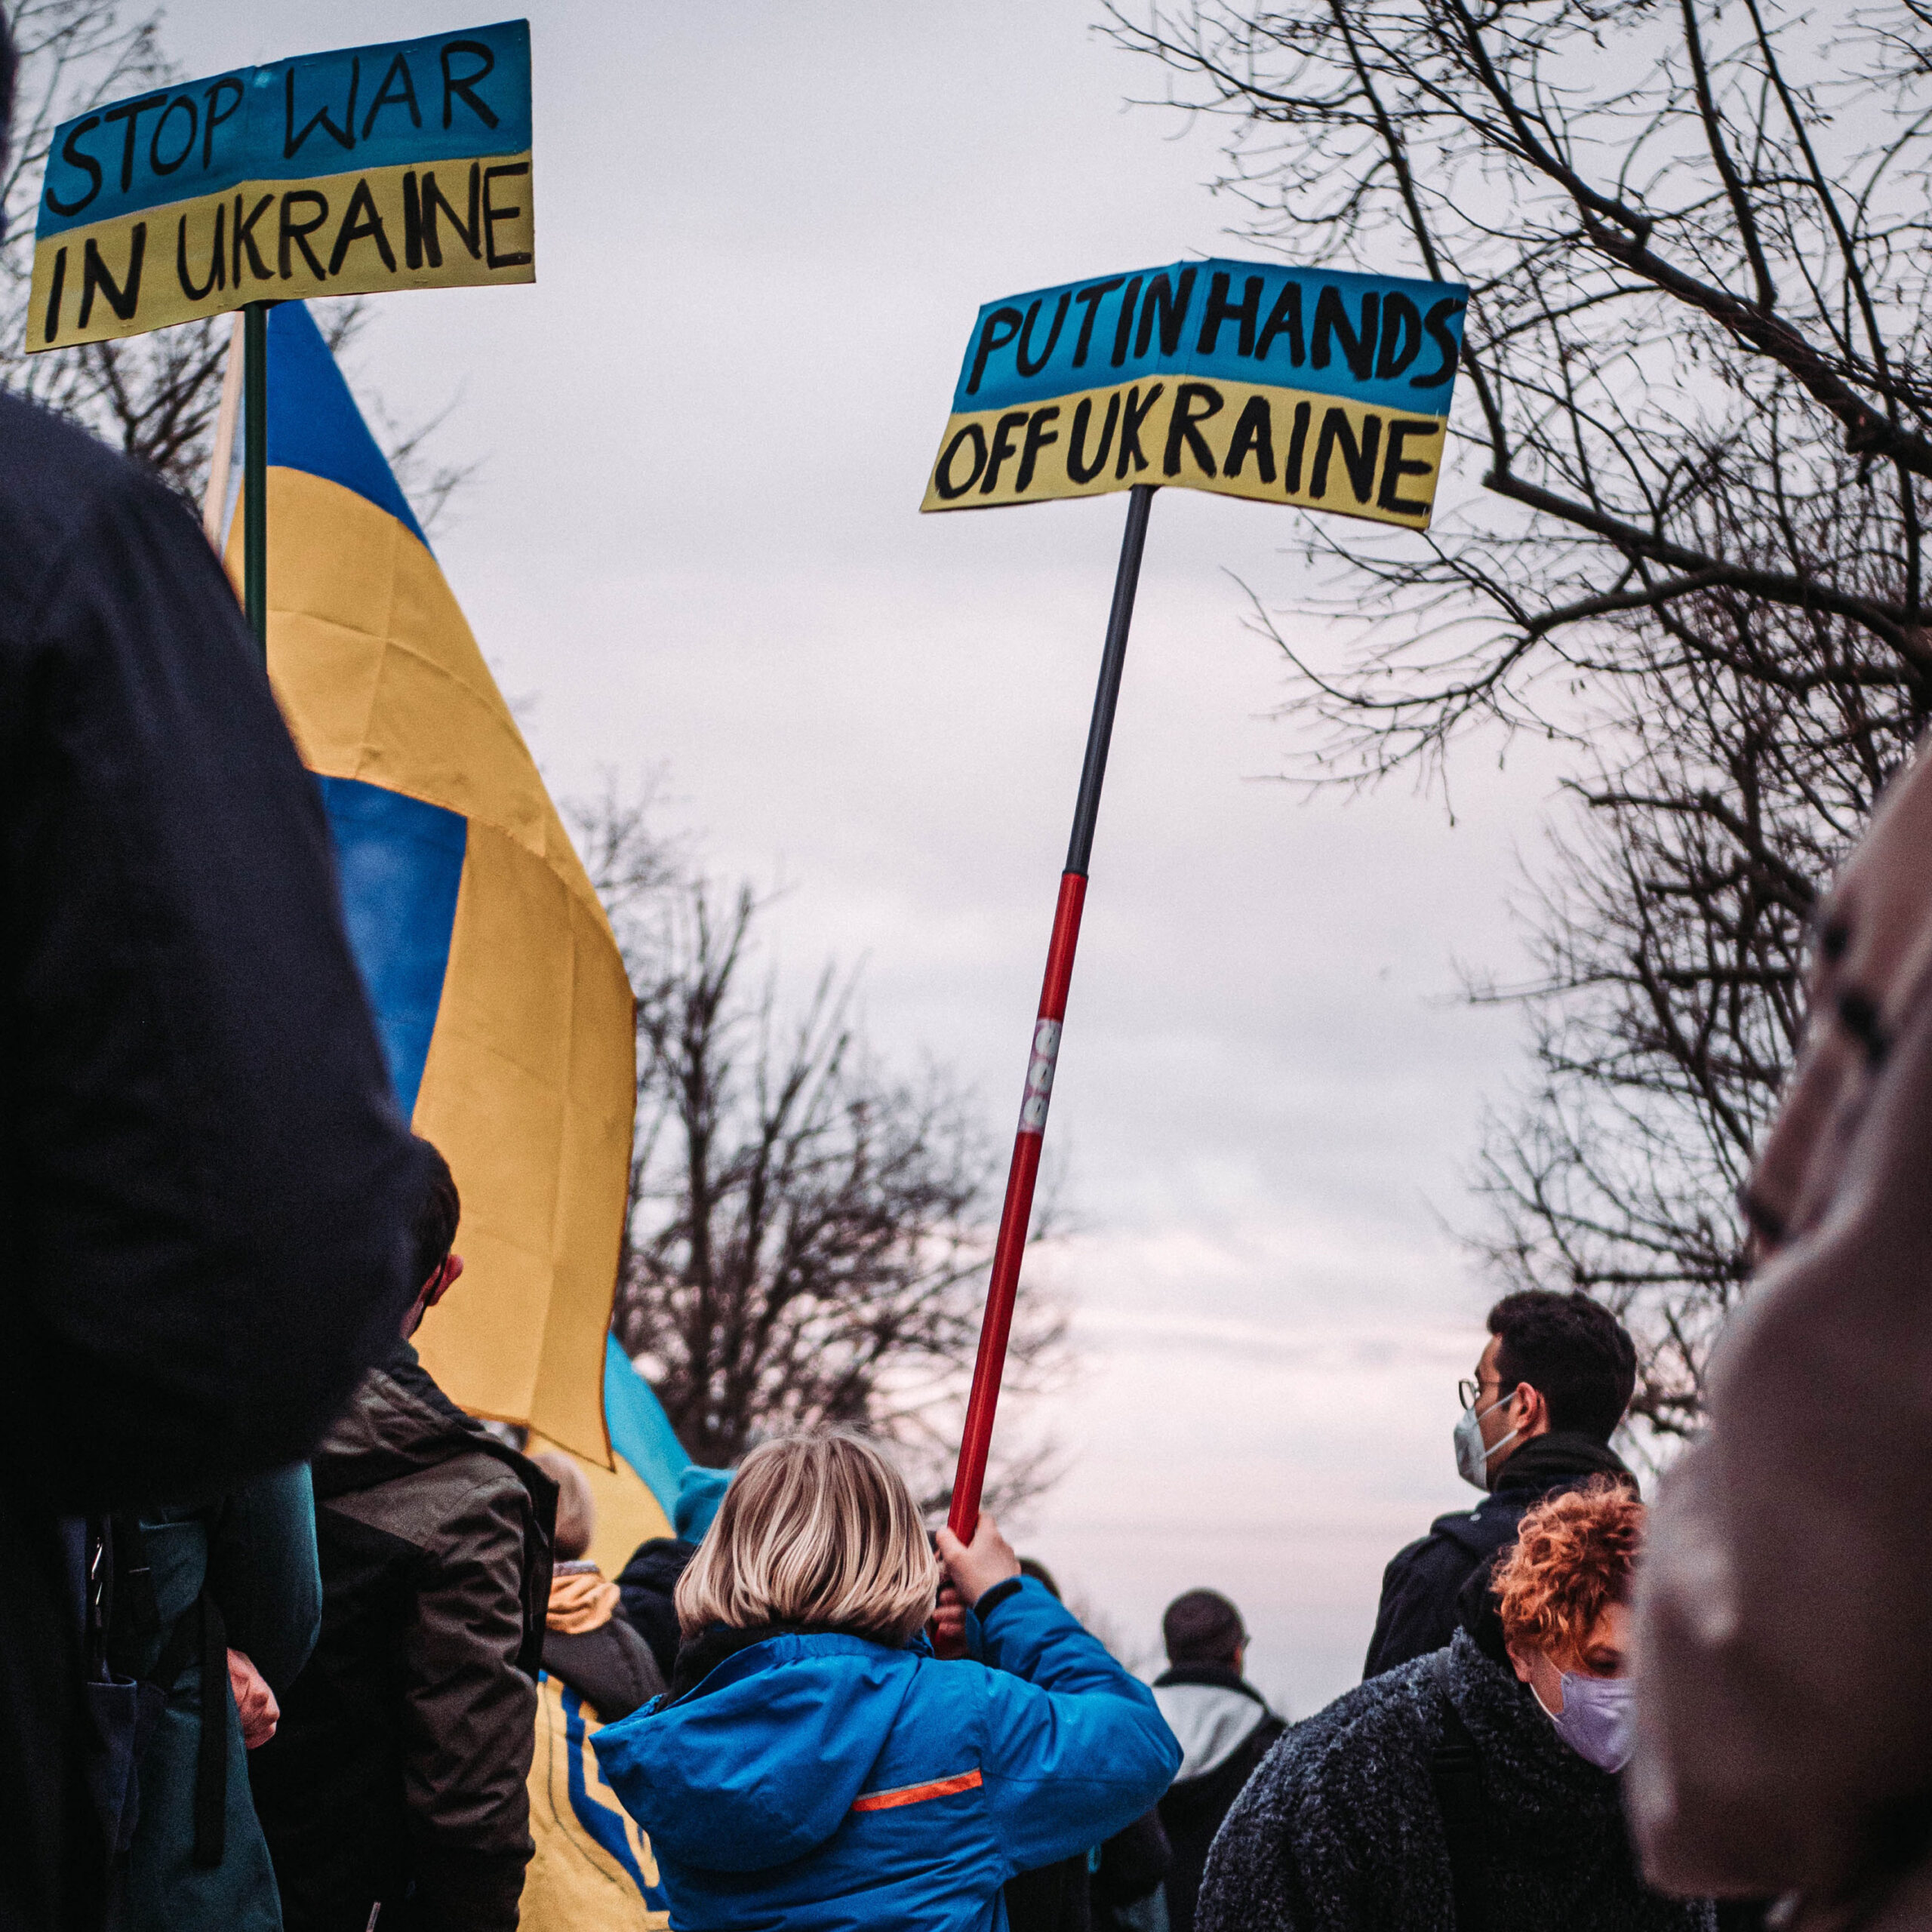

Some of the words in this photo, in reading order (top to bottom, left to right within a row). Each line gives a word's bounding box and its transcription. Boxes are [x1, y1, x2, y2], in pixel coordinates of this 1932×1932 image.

[46, 77, 245, 217] STOP
[284, 39, 500, 160] WAR
[45, 221, 147, 343] IN
[177, 157, 532, 300] UKRAINE
[965, 267, 1197, 395] PUTIN
[1196, 272, 1464, 388] HANDS
[934, 407, 1060, 500] OFF
[1066, 382, 1440, 515] UKRAINE
